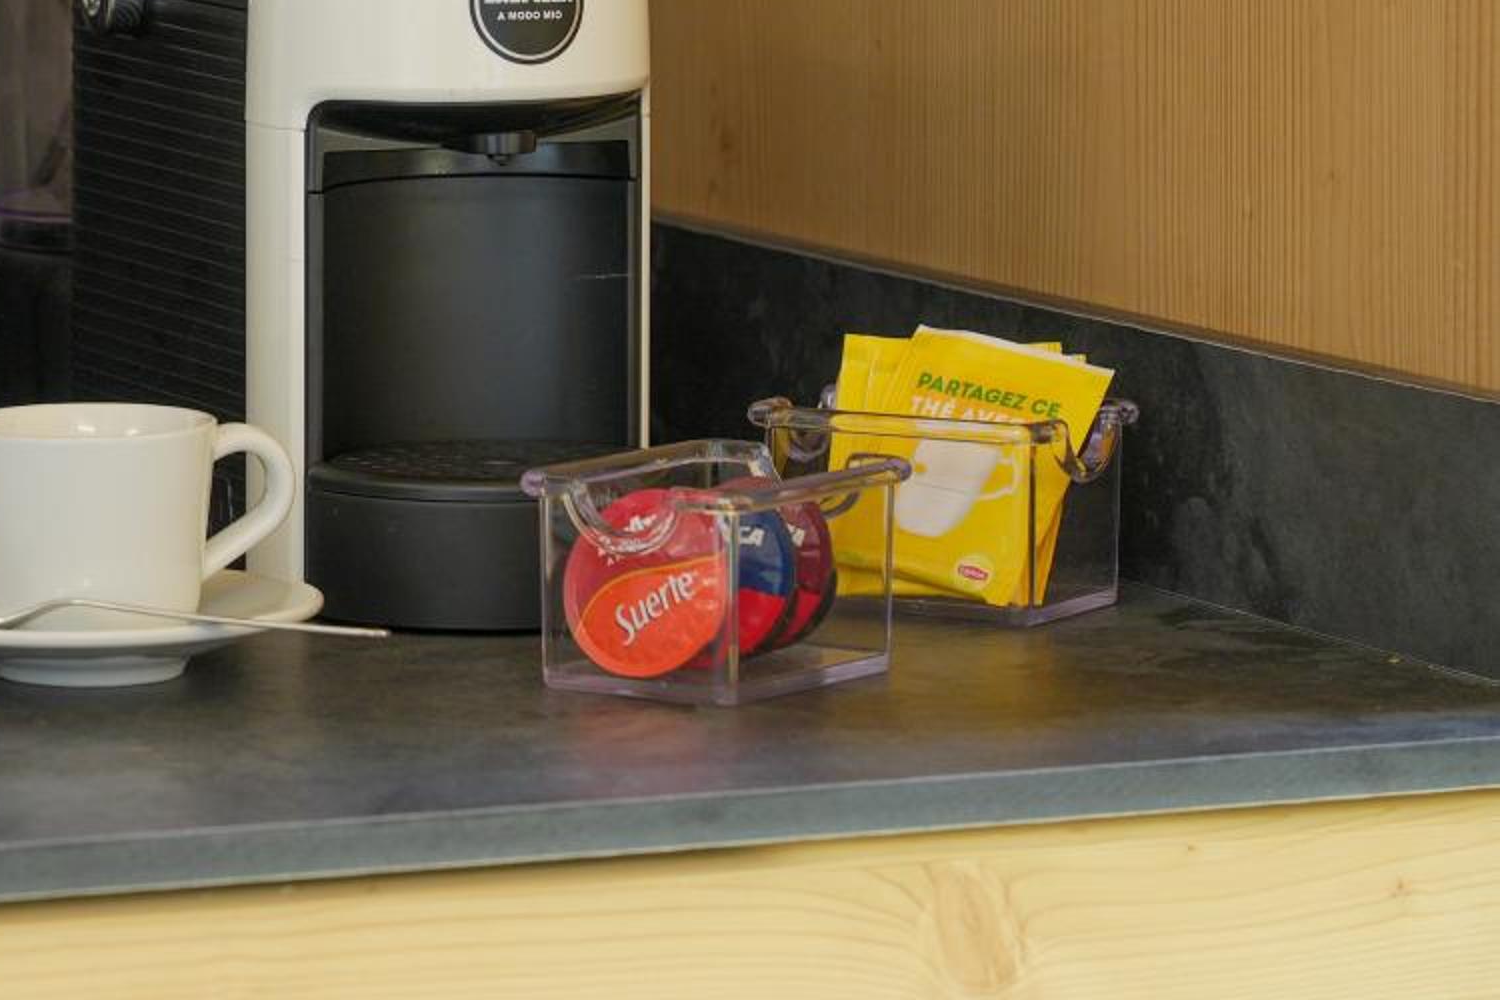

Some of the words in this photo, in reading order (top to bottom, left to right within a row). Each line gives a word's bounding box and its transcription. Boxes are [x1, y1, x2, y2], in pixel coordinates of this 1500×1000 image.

[497, 11, 506, 20] A
[508, 11, 541, 20] MODO
[543, 10, 563, 20] MIO
[916, 371, 1028, 410] PARTAGEZ
[1031, 398, 1061, 418] CE
[615, 571, 694, 645] Suerte
